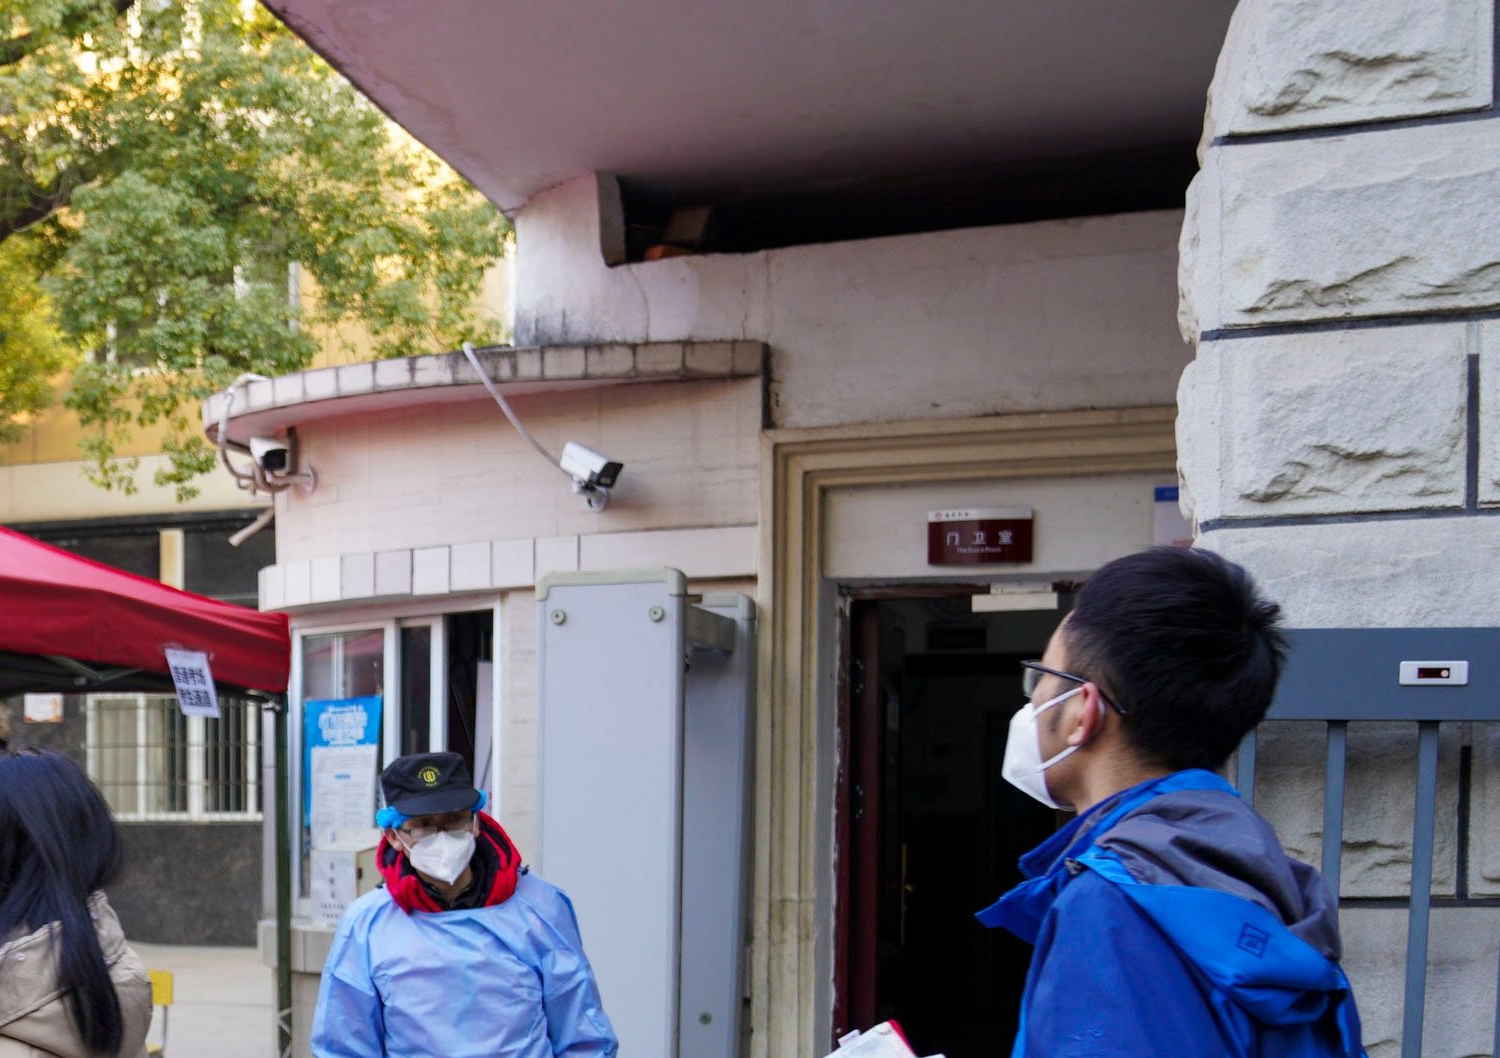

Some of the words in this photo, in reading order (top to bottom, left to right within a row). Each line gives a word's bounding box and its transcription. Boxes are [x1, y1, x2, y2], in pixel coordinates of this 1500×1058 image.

[946, 530, 1013, 546] 门卫室
[172, 665, 206, 685] 普通考场
[178, 687, 213, 708] 考生通道
